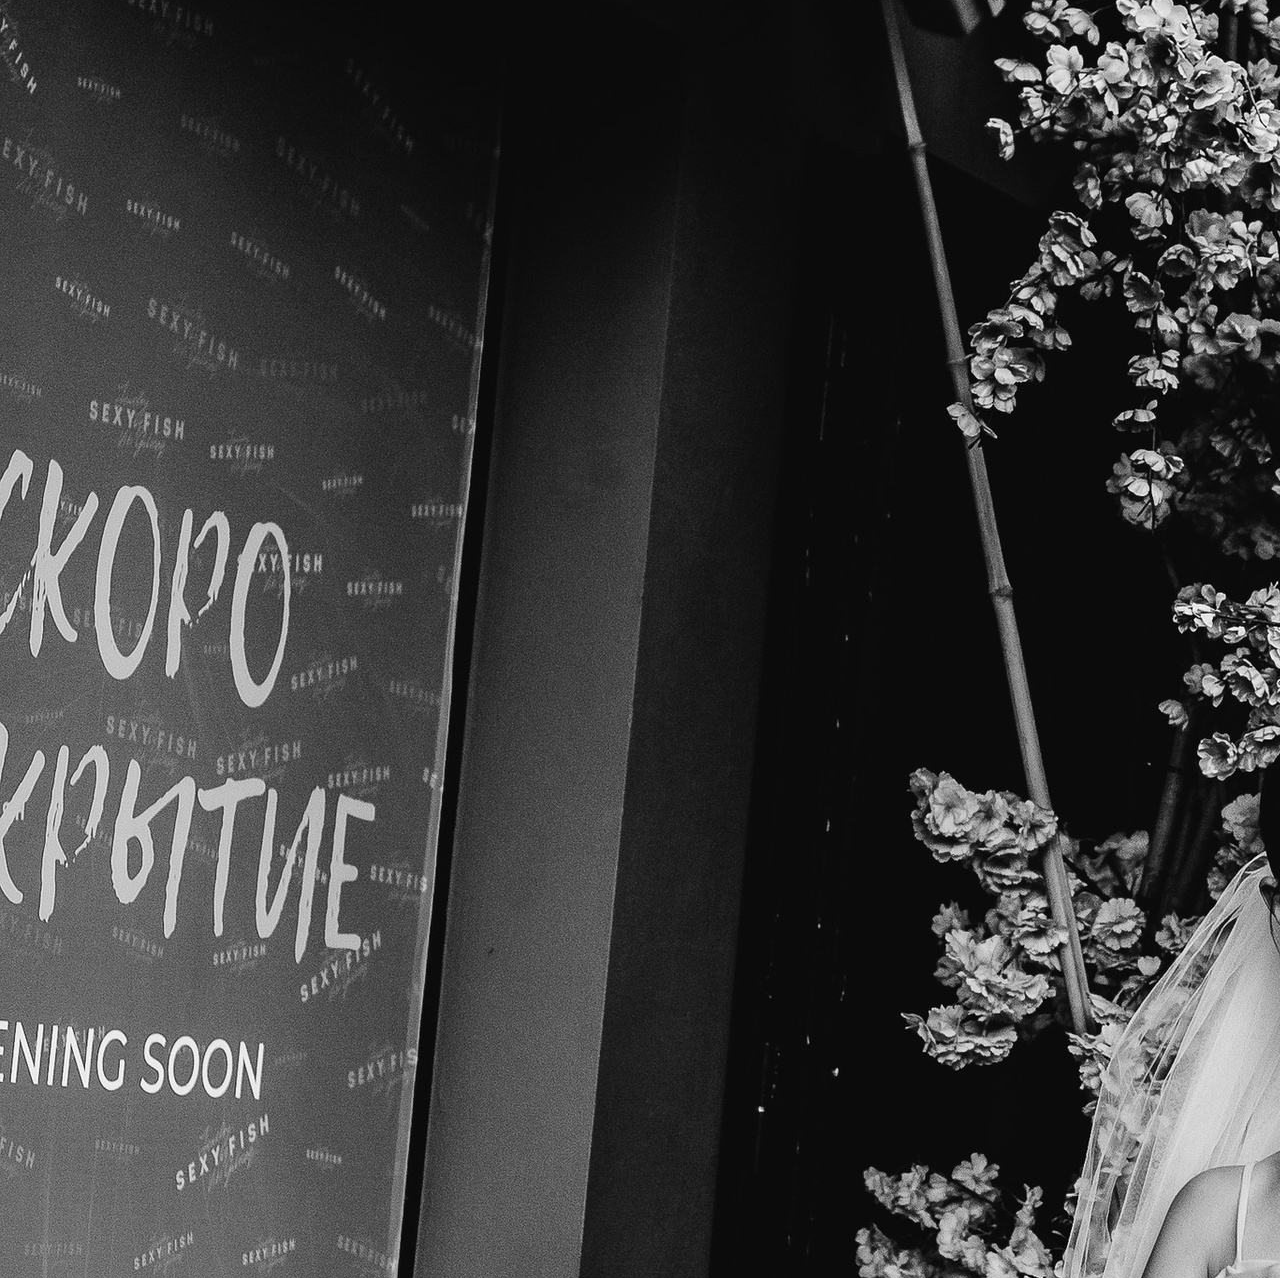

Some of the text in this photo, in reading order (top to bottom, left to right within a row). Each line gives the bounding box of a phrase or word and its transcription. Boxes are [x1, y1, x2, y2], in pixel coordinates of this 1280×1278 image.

[8, 39, 38, 95] FISH
[44, 169, 88, 216] FISH
[126, 199, 181, 231] SEXY FISH
[55, 275, 111, 318] SEXY FISH
[147, 297, 239, 371] SEXY FISH
[89, 398, 186, 440] SEXY FISH
[209, 444, 275, 460] SEXY FISH
[346, 580, 403, 596] SEXY FISH
[291, 655, 358, 691] SEXY FISH
[105, 715, 198, 759] SEXY FISH
[216, 740, 302, 776] SEXY FISH
[328, 765, 391, 789] SEXY FISH
[370, 864, 401, 886] SEXY
[213, 944, 267, 966] SEXY FISH
[300, 961, 339, 1003] SEXY
[140, 1033, 265, 1100] SOON
[347, 1058, 384, 1090] SEXY
[0, 1136, 36, 1170] FISH
[174, 1145, 220, 1192] SEXY
[228, 1114, 270, 1157] FISH
[133, 1230, 195, 1271] SEXY FISH
[242, 1238, 296, 1266] SEXY FISH
